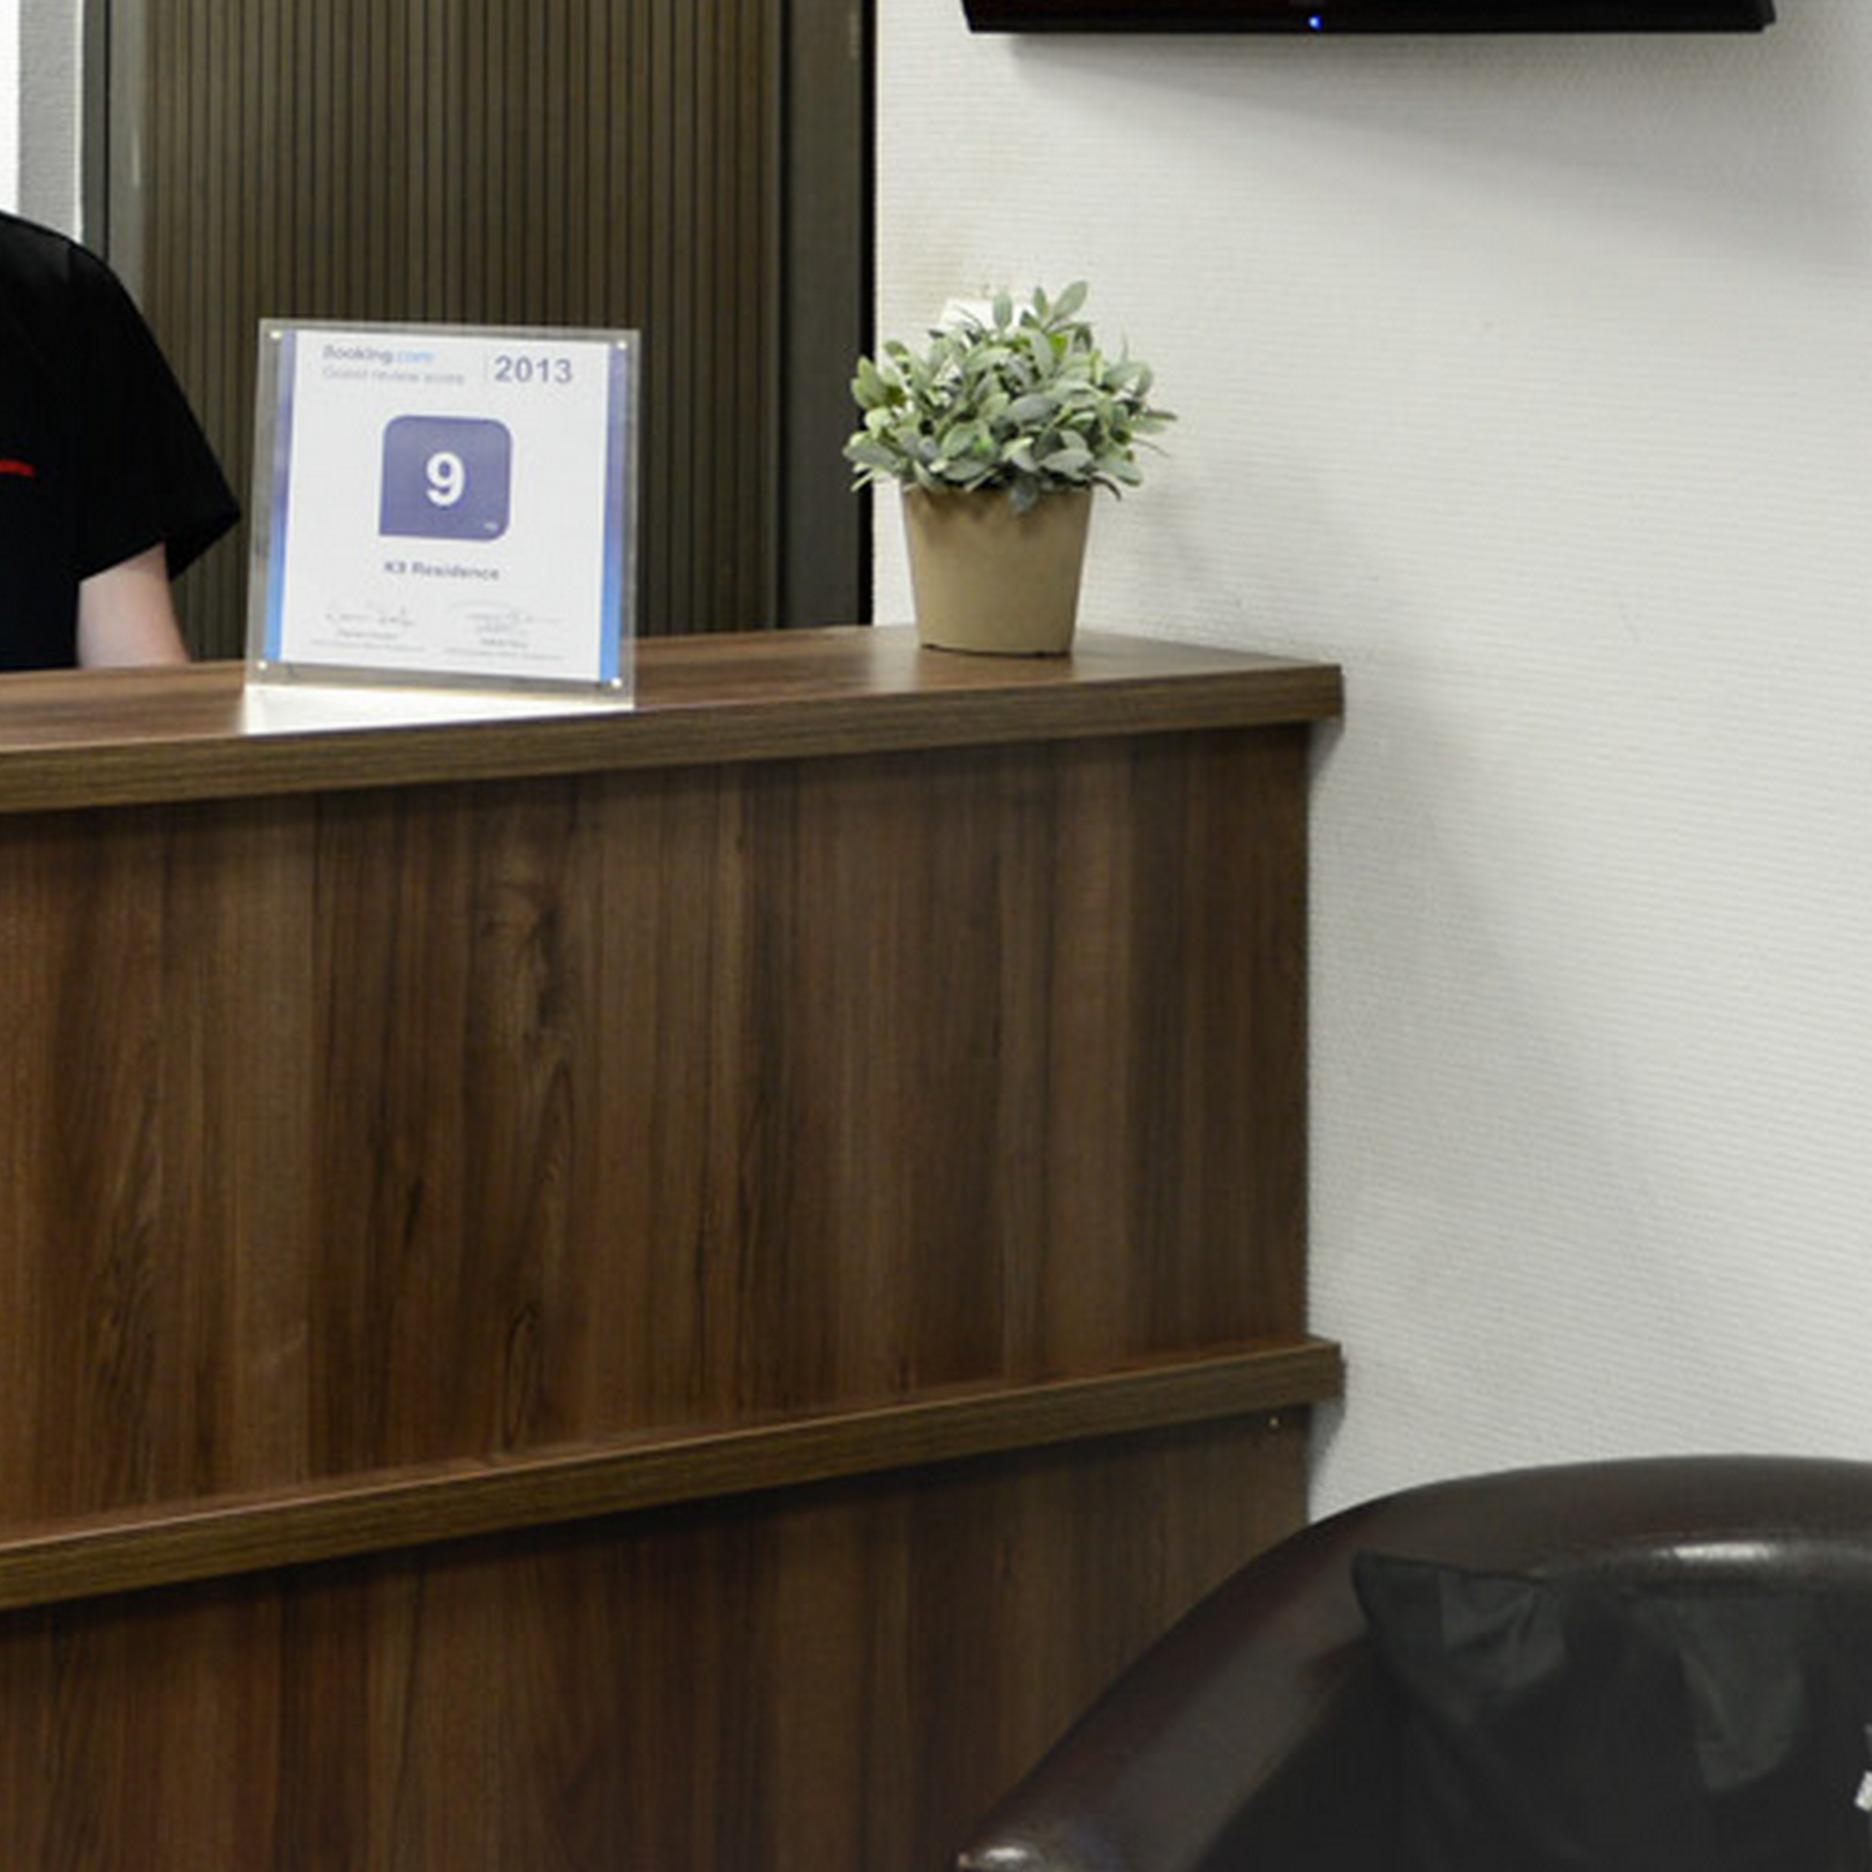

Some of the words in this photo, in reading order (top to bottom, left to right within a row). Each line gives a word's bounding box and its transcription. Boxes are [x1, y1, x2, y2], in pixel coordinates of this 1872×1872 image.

[493, 354, 574, 385] 2013
[425, 450, 466, 507] 9
[411, 561, 500, 581] Residence
